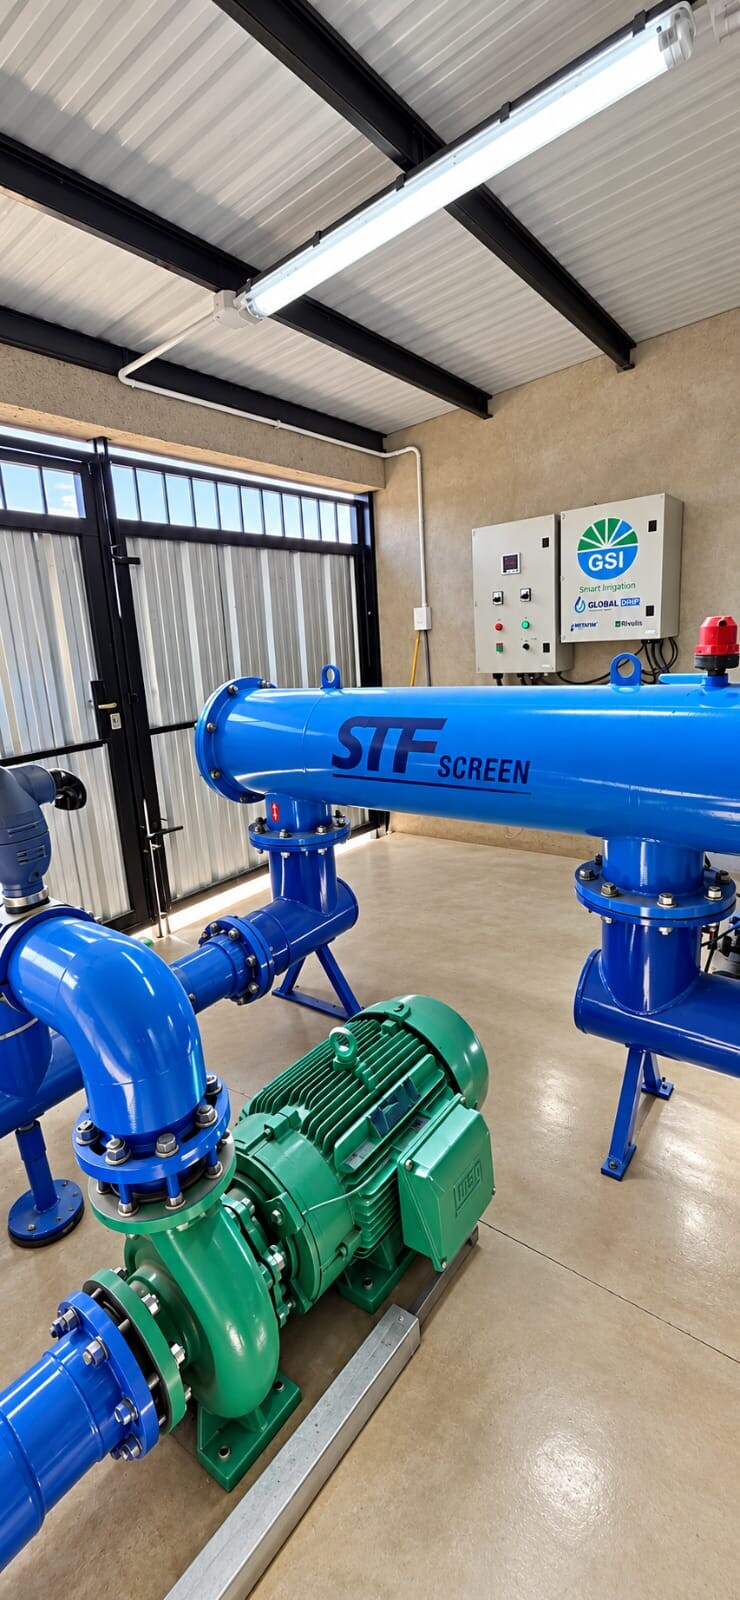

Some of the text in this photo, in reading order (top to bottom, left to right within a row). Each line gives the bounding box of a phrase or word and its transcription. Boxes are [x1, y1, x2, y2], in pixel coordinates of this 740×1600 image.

[588, 551, 624, 572] GSI
[579, 582, 636, 594] Smart Irrigation
[588, 600, 619, 608] GLOBAL
[331, 715, 448, 774] STF
[437, 755, 531, 785] SCREEN
